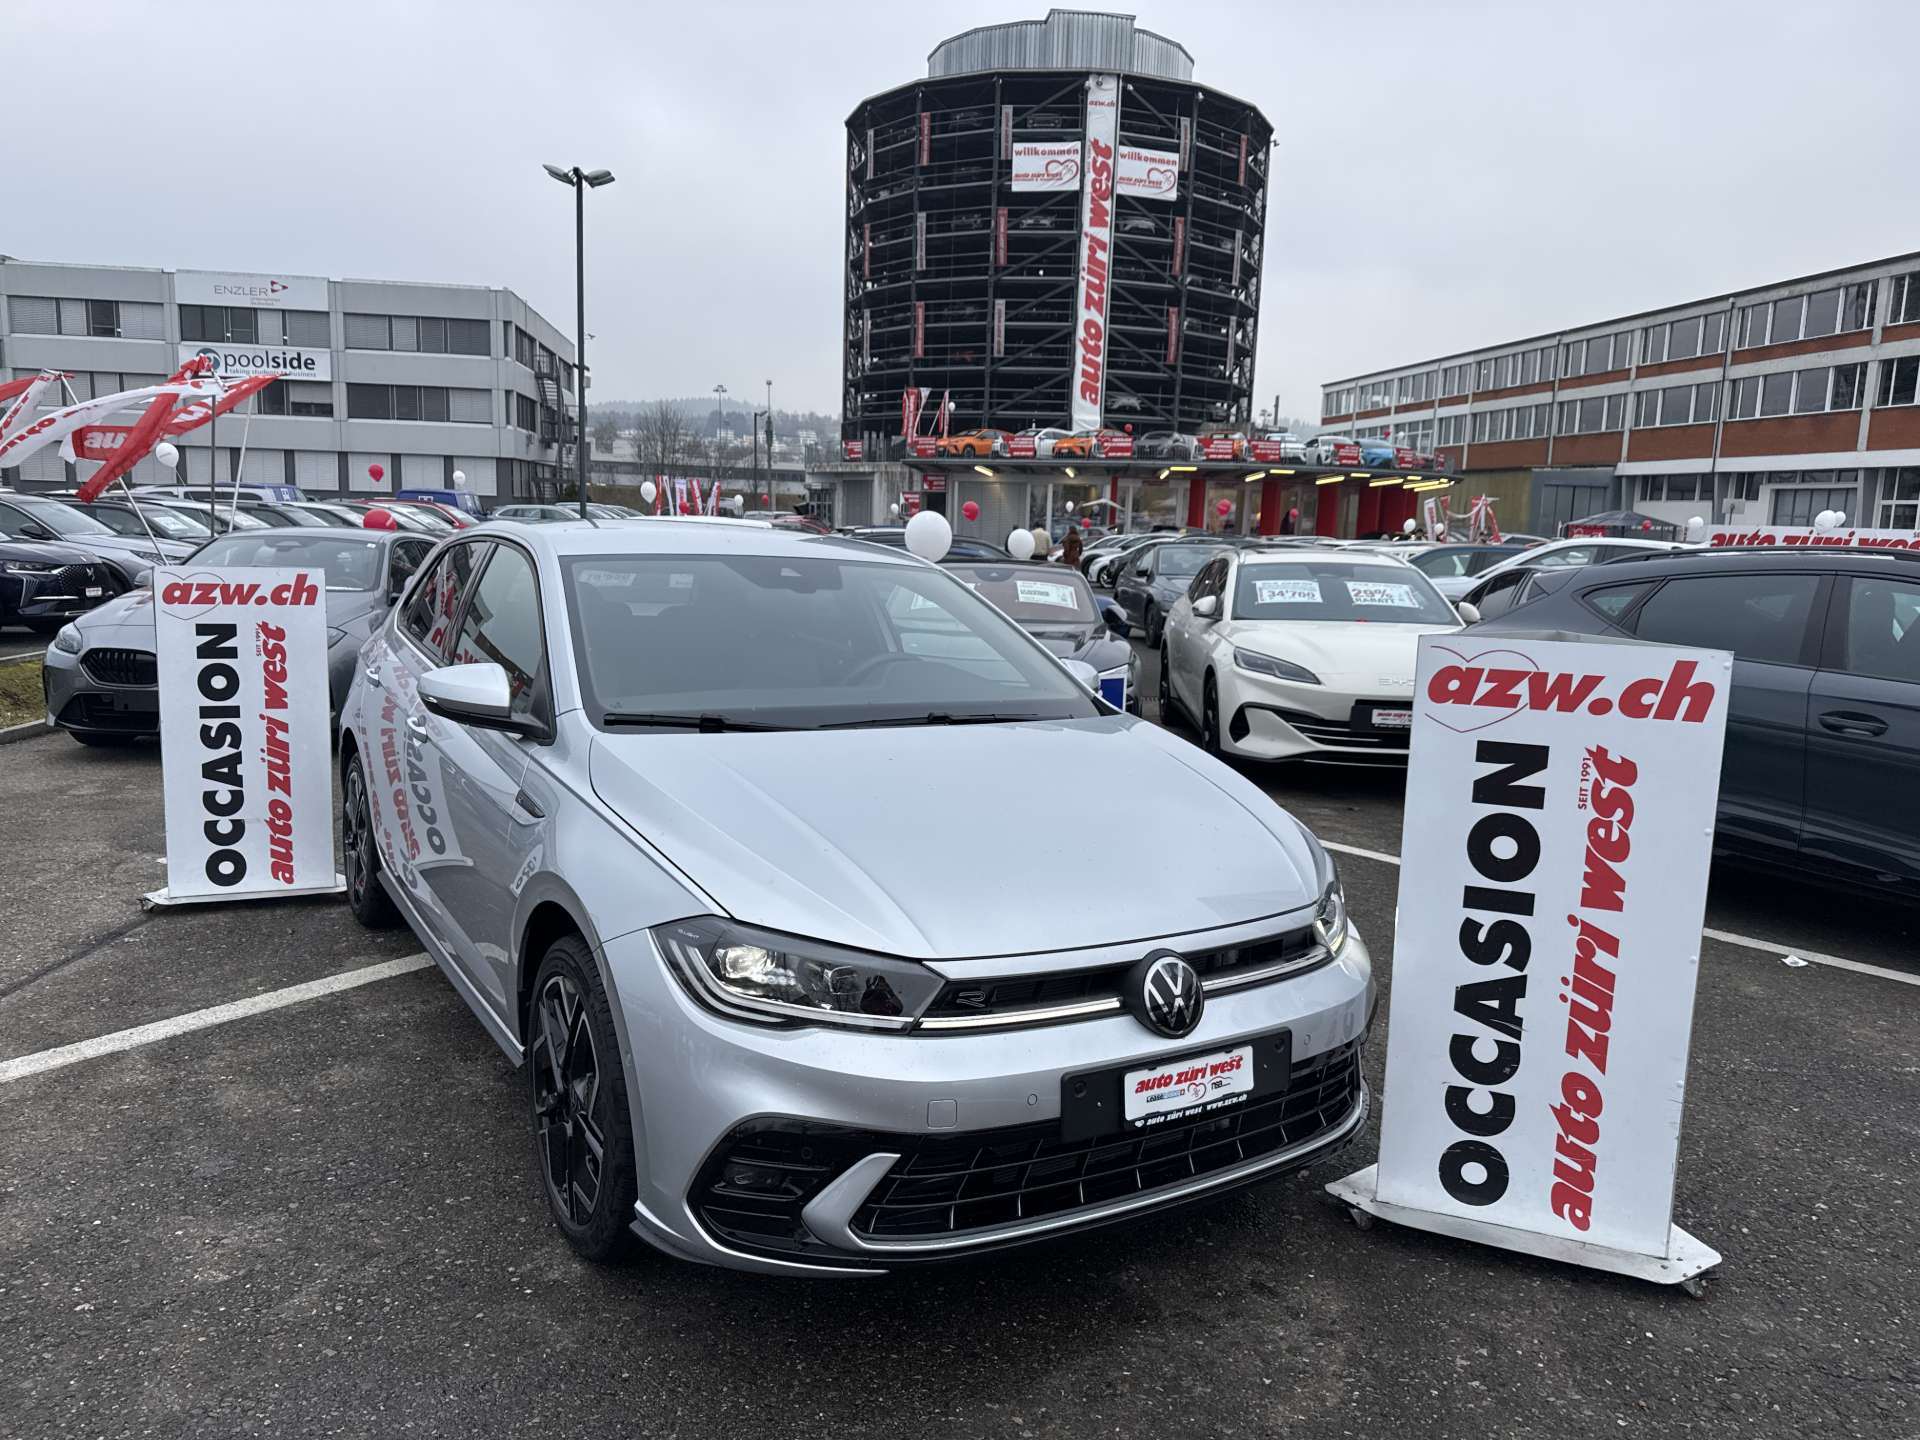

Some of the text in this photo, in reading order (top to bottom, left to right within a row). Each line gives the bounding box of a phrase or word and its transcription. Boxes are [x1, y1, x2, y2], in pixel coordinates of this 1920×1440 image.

[1014, 147, 1079, 157] willkommen
[1119, 151, 1177, 166] willkommen
[214, 285, 268, 297] ENZLER
[1079, 136, 1113, 406] auto züri west
[223, 350, 316, 373] poolside
[162, 573, 319, 606] azw.ch
[1427, 660, 1715, 724] azw.ch
[195, 623, 247, 887] OCCASION
[258, 620, 295, 885] auto züri west
[1578, 757, 1592, 810] SEIT 1991
[1438, 739, 1550, 1207] OCCASION
[1550, 743, 1639, 1233] auto züri west
[1134, 1072, 1174, 1095] auto
[1174, 1063, 1209, 1086] züri
[1209, 1055, 1244, 1077] west
[1146, 1107, 1203, 1126] auto züri west
